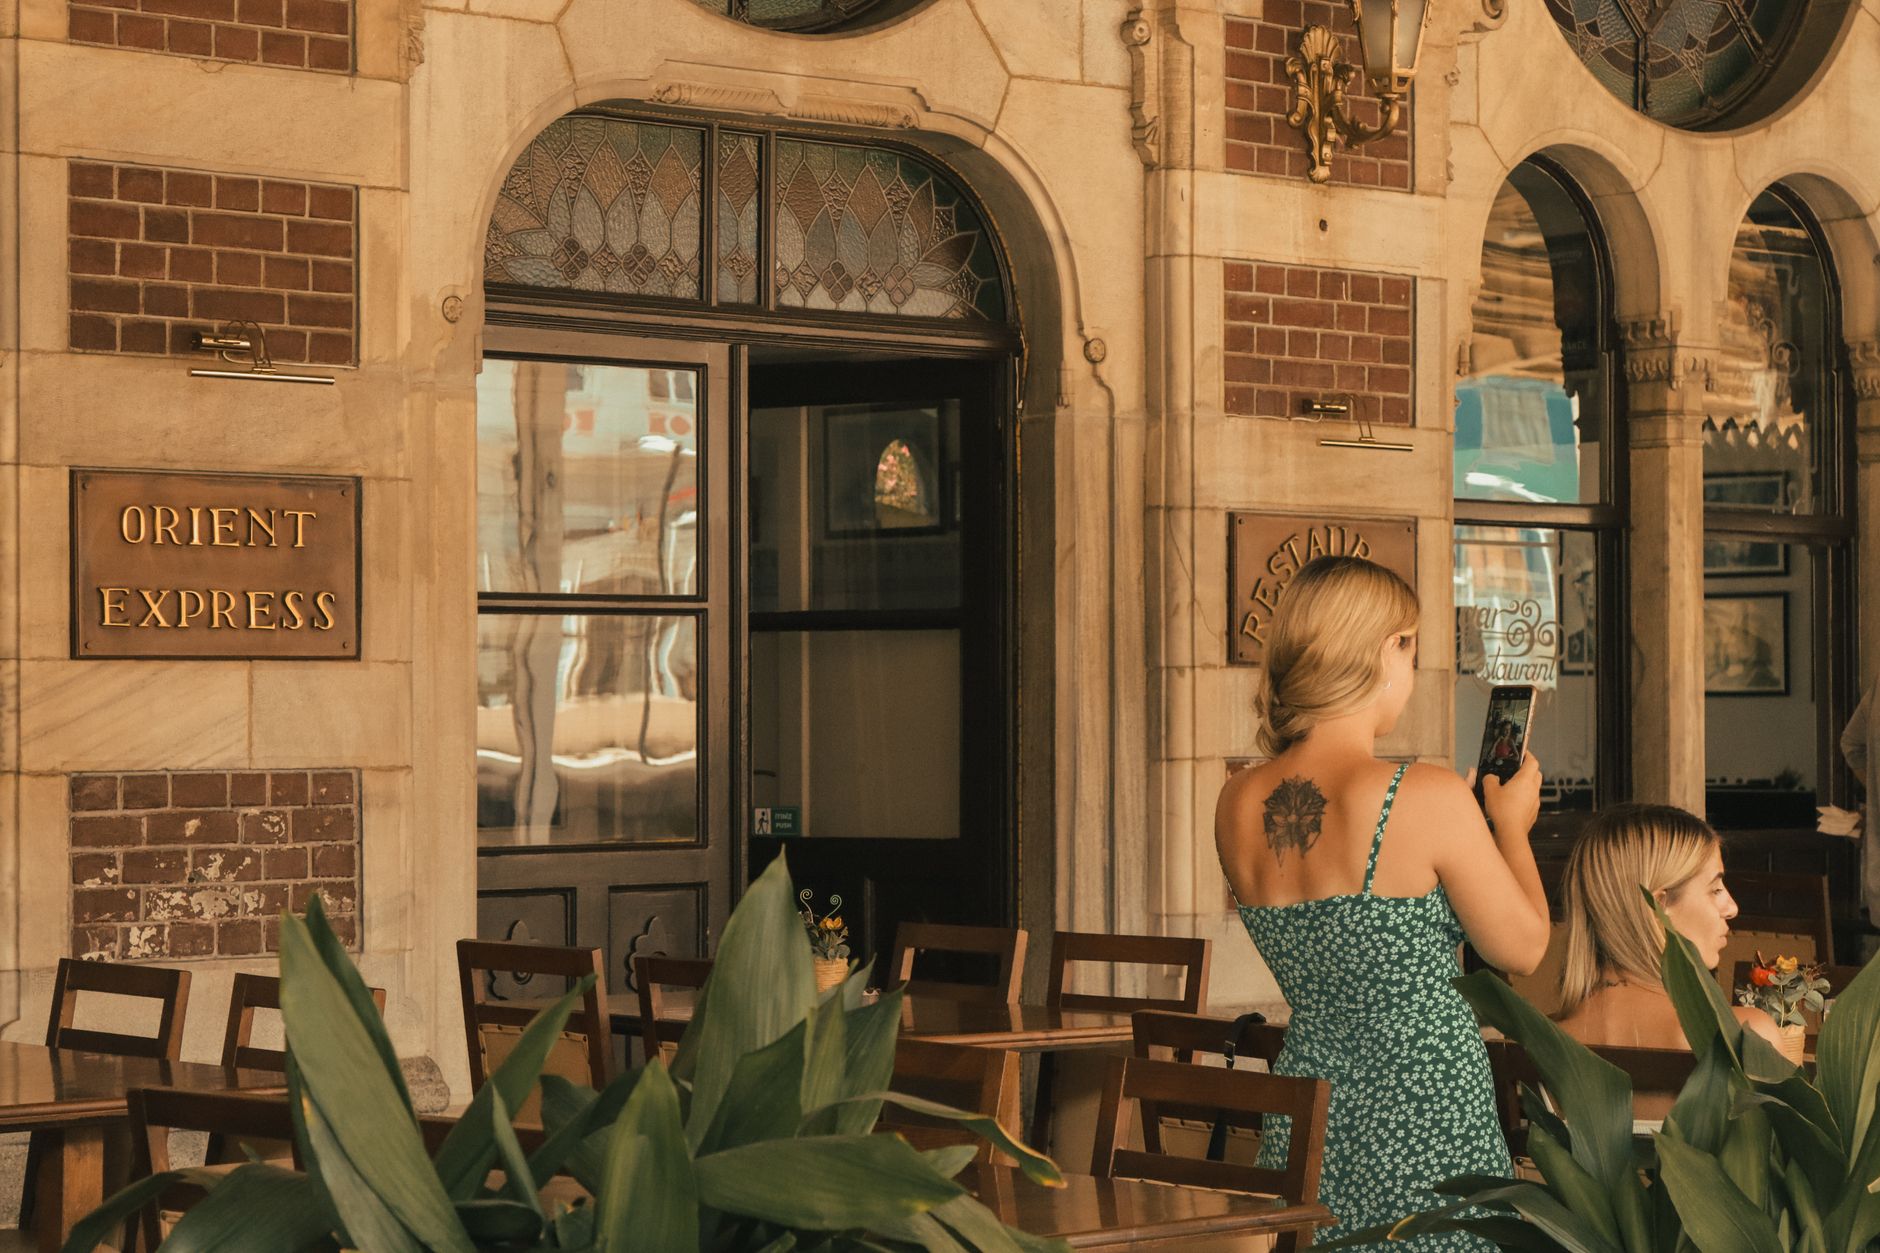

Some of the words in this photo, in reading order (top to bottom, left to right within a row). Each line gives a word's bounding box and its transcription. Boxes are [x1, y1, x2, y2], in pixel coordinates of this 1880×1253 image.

[120, 505, 317, 548] ORIENT
[1239, 524, 1372, 647] RESTAUR
[98, 586, 336, 631] EXPRESS
